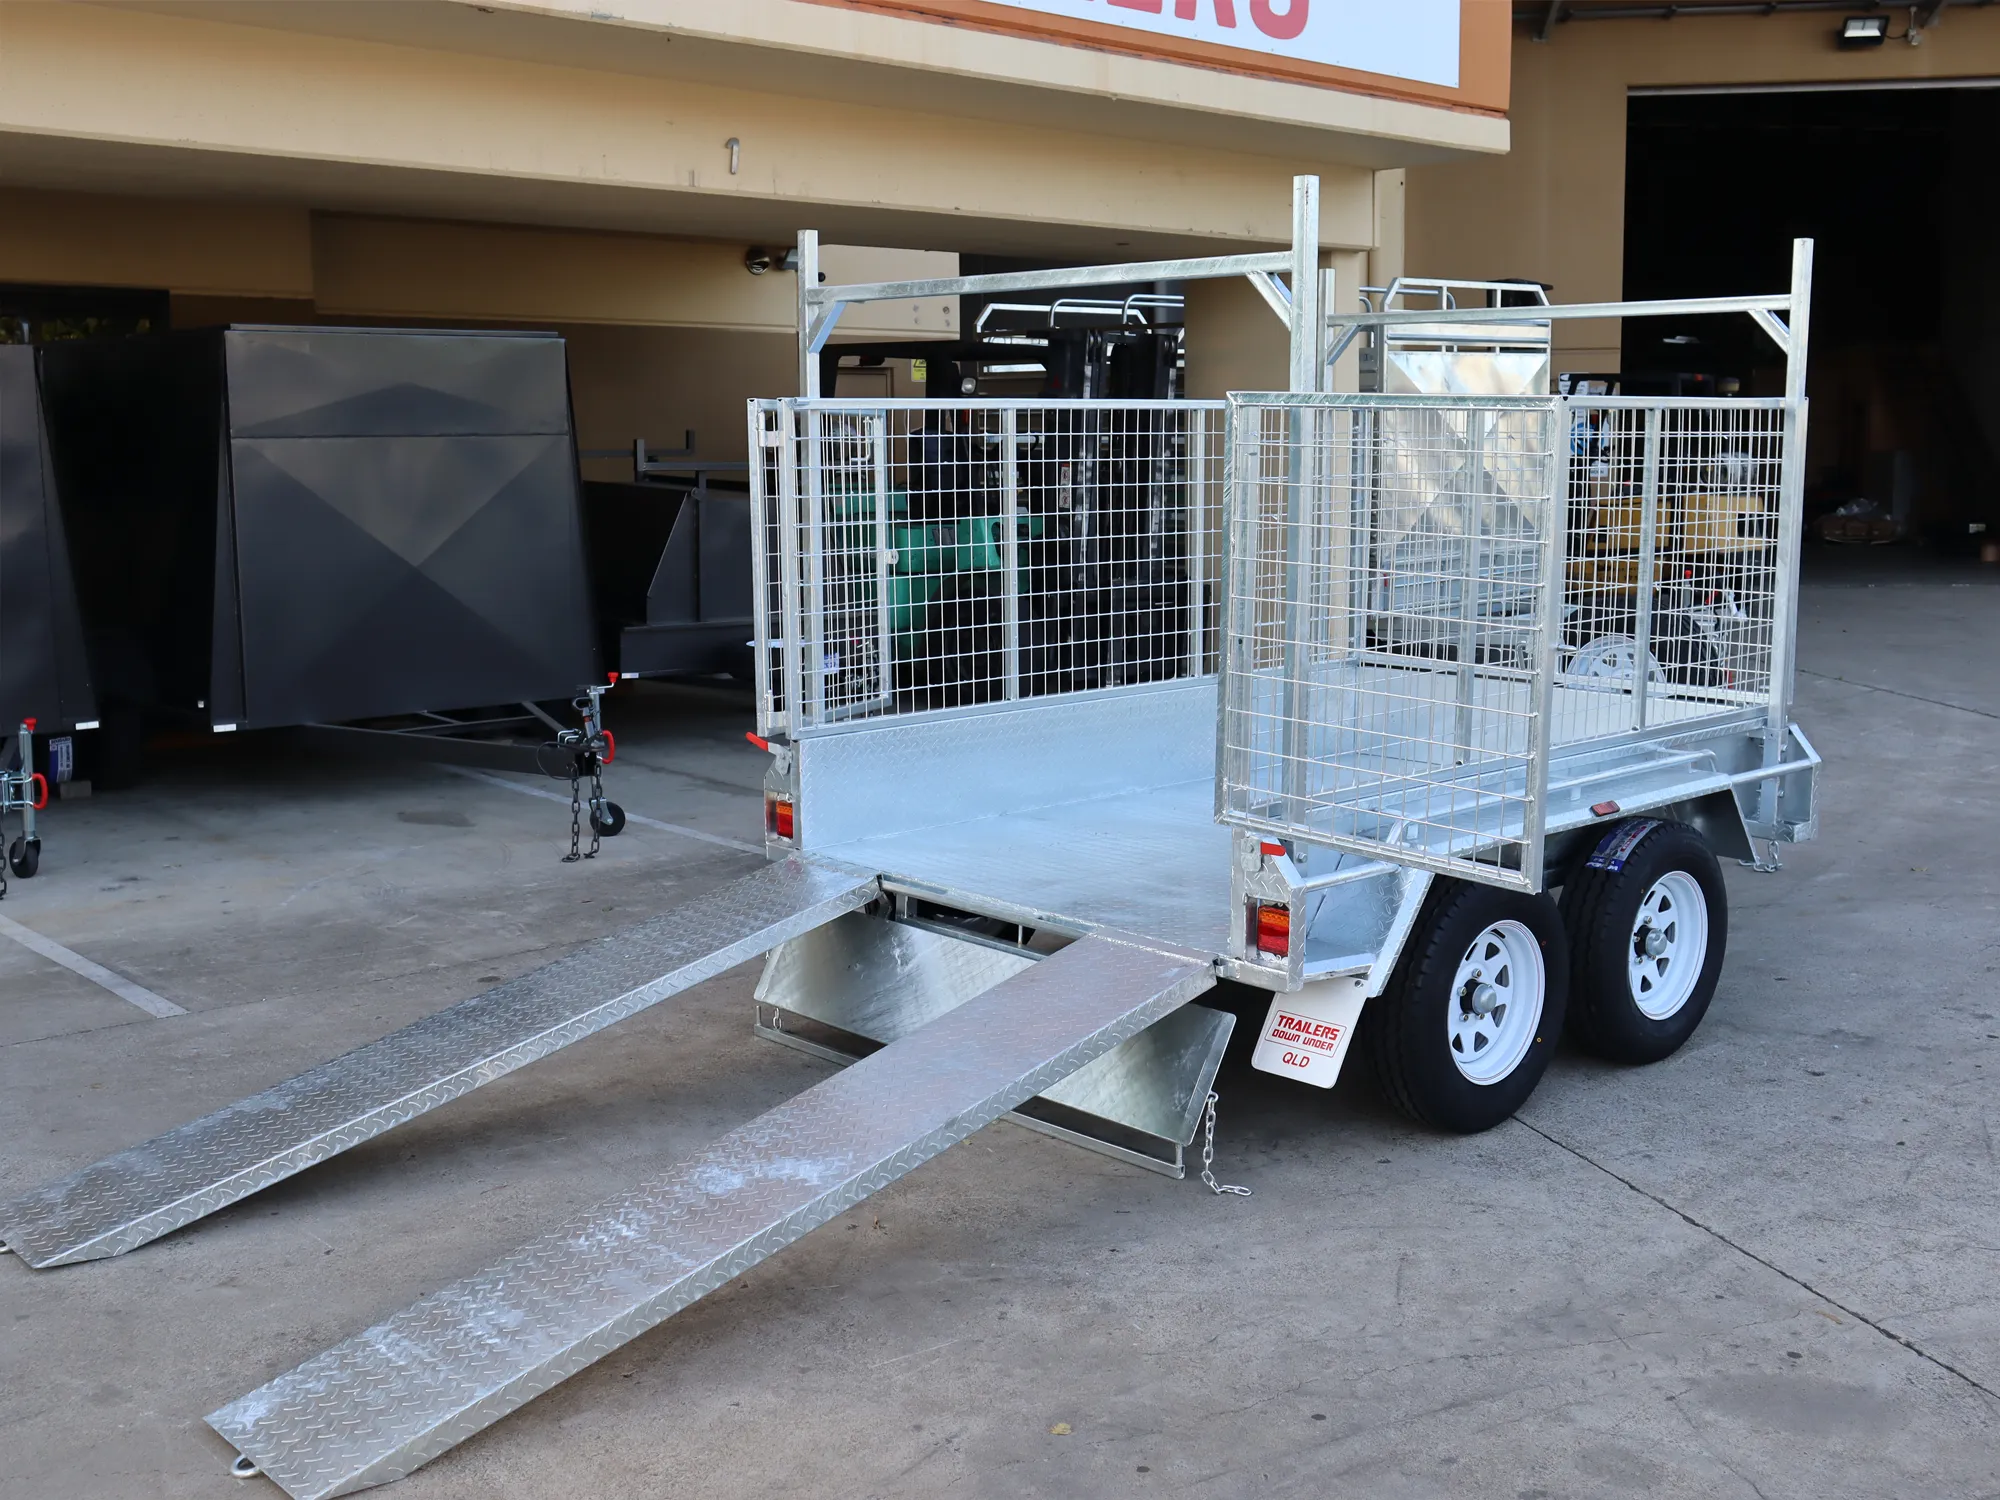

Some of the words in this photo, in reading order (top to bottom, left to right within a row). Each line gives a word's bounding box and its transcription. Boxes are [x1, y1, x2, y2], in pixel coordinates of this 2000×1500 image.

[1278, 1015, 1340, 1041] TRAILERS
[1272, 1029, 1301, 1042] DOWN
[1302, 1036, 1334, 1051] UNDER
[1282, 1052, 1310, 1068] QLD
